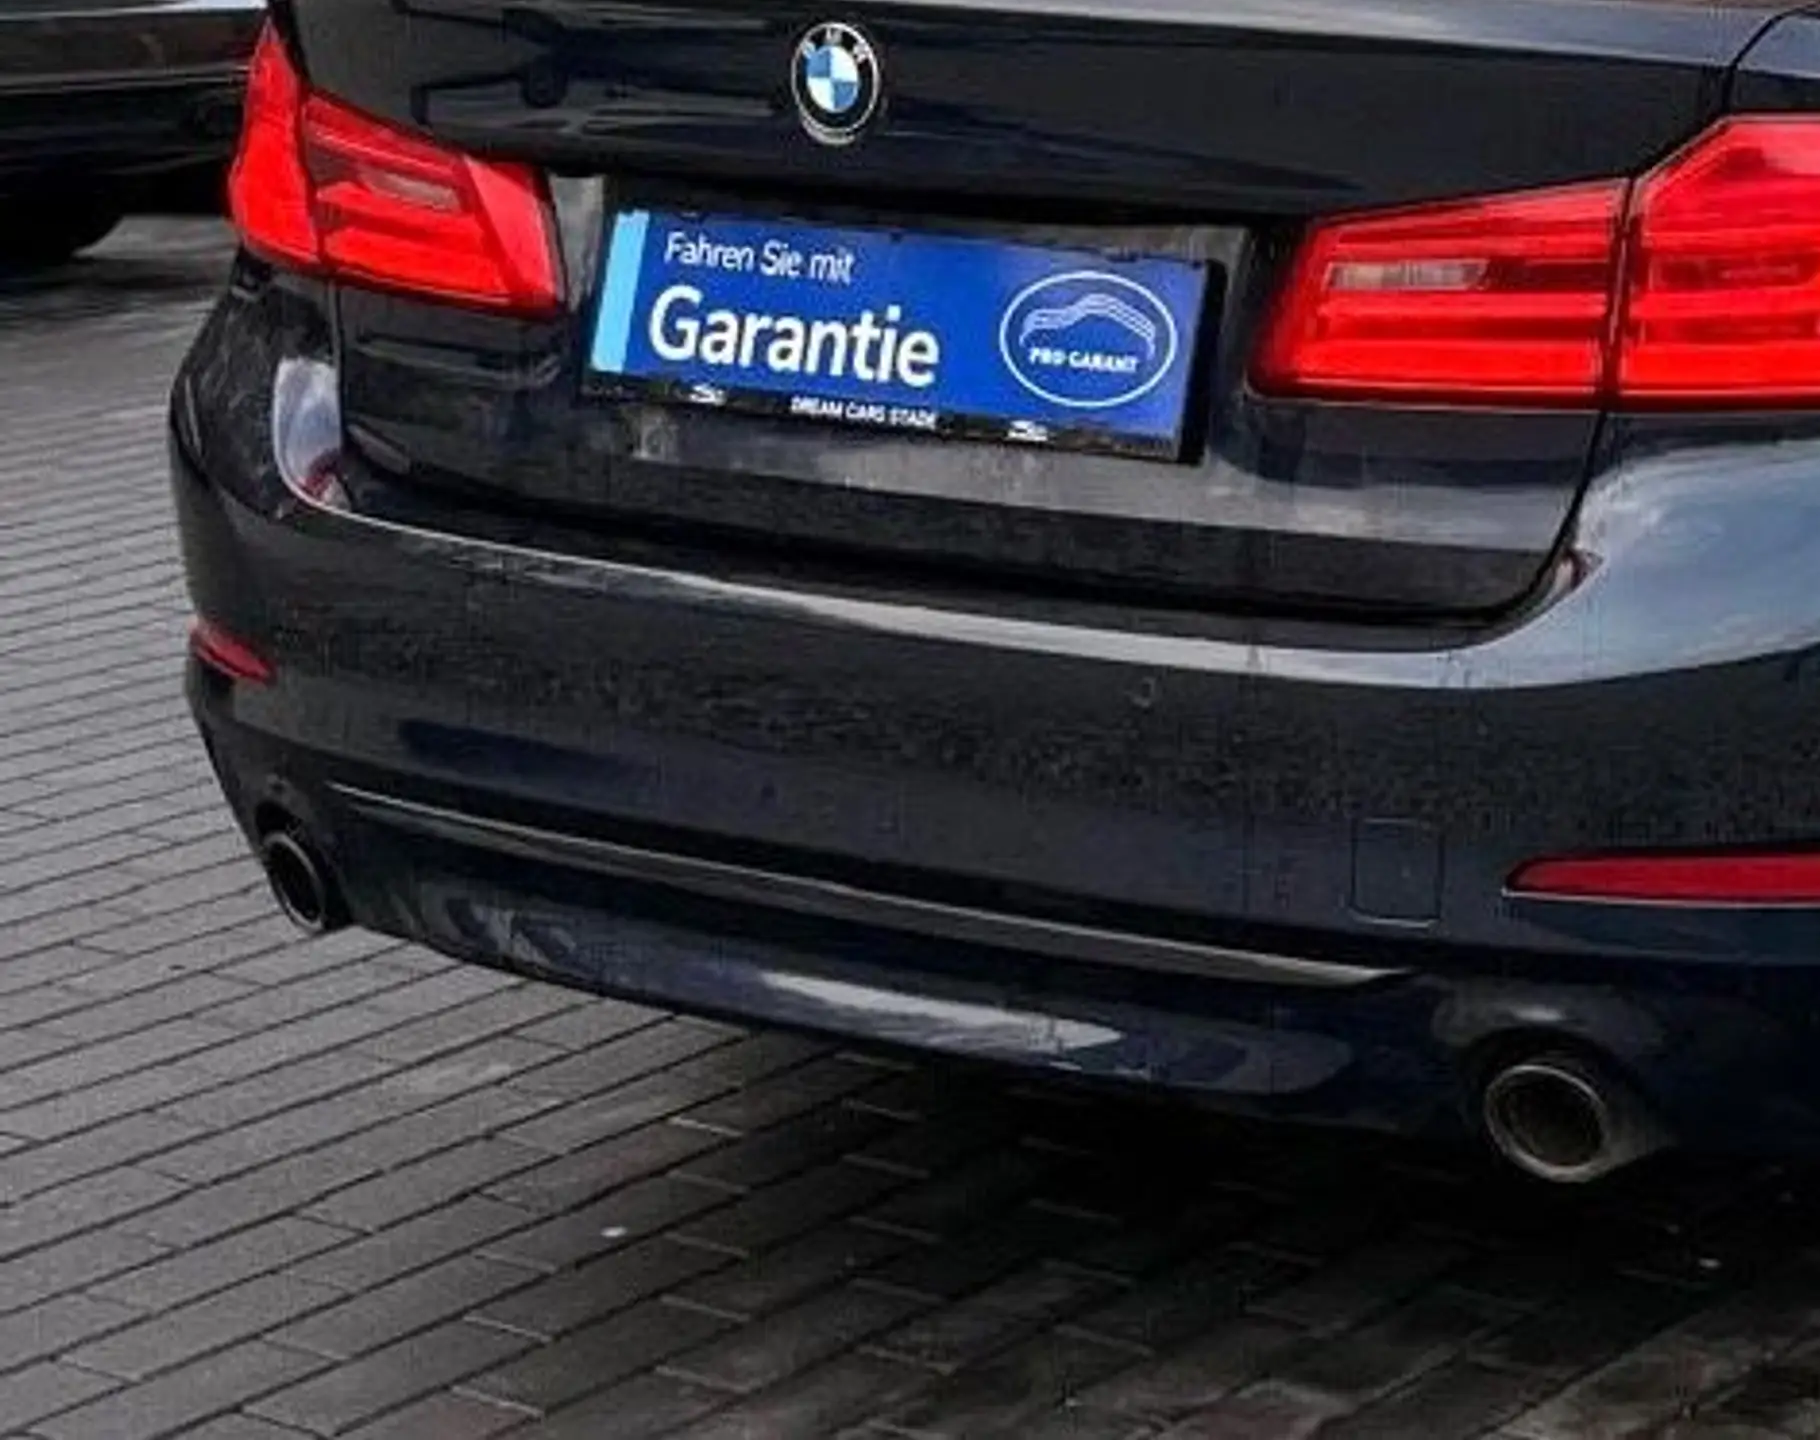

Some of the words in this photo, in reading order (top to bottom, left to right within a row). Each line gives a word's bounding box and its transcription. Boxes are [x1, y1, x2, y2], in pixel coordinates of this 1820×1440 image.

[663, 231, 755, 272] Fahren
[759, 239, 802, 278] Sie
[808, 246, 856, 286] mit
[649, 284, 941, 389] Garantie
[790, 395, 843, 420] DREAM
[845, 401, 886, 424] CARS
[889, 406, 937, 431] STADE
